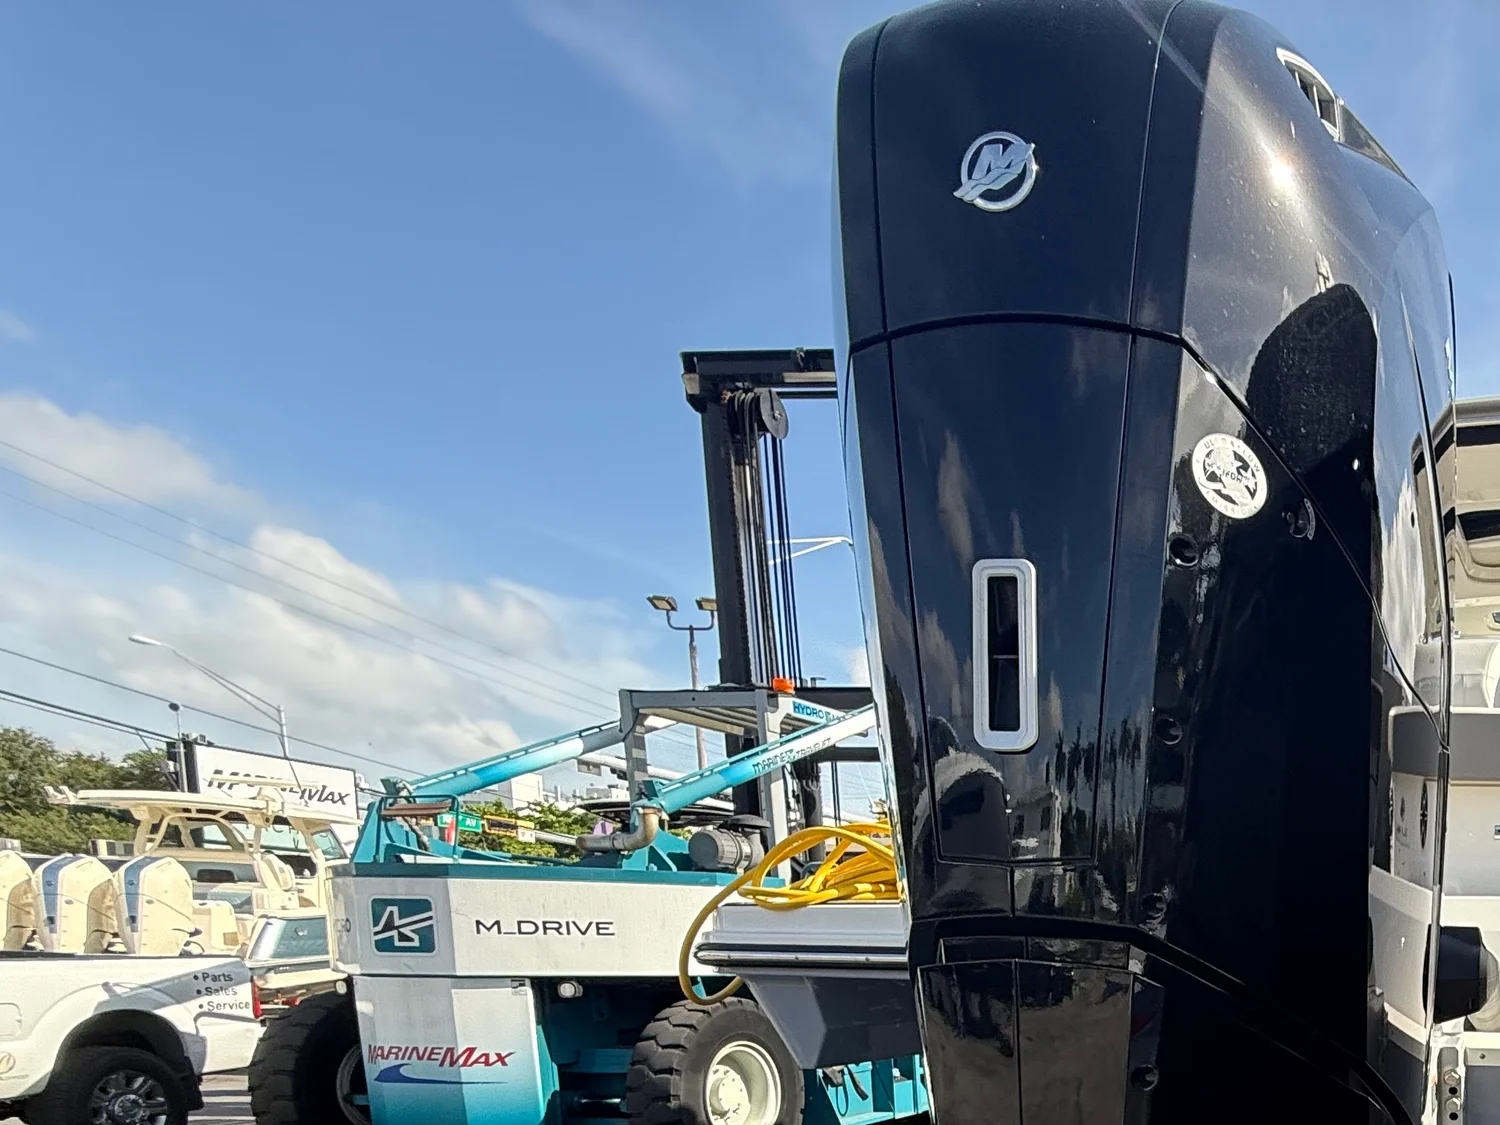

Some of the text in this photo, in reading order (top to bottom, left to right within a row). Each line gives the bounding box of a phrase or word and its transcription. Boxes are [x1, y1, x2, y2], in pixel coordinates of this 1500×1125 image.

[793, 700, 824, 720] HYDRO
[207, 768, 351, 806] MAEMAX
[474, 919, 616, 937] M_DRIVE
[202, 972, 234, 983] Parts
[204, 986, 238, 997] Sales
[207, 1000, 251, 1012] Service
